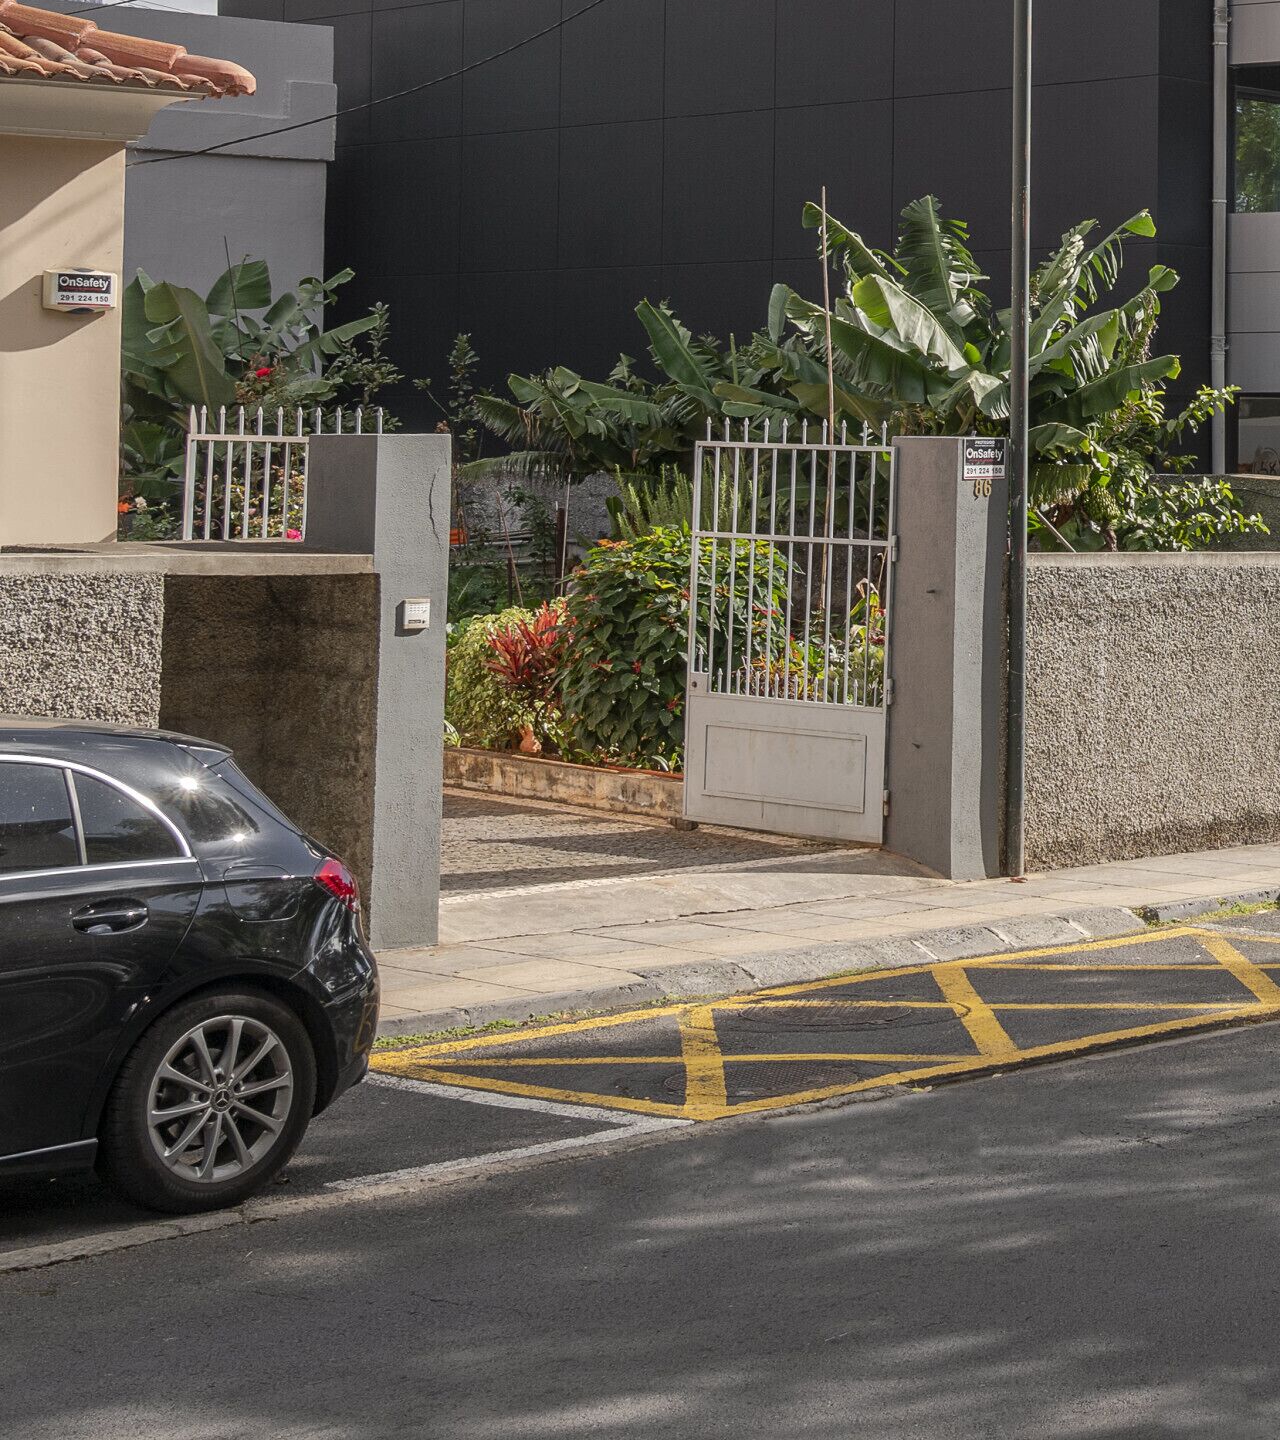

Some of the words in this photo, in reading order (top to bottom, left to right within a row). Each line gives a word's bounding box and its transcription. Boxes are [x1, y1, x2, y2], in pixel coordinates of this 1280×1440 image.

[60, 276, 109, 291] OnSafety
[966, 447, 1003, 462] OnSafety
[966, 467, 977, 475] 291
[979, 467, 990, 475] 224
[992, 467, 1003, 475] 150
